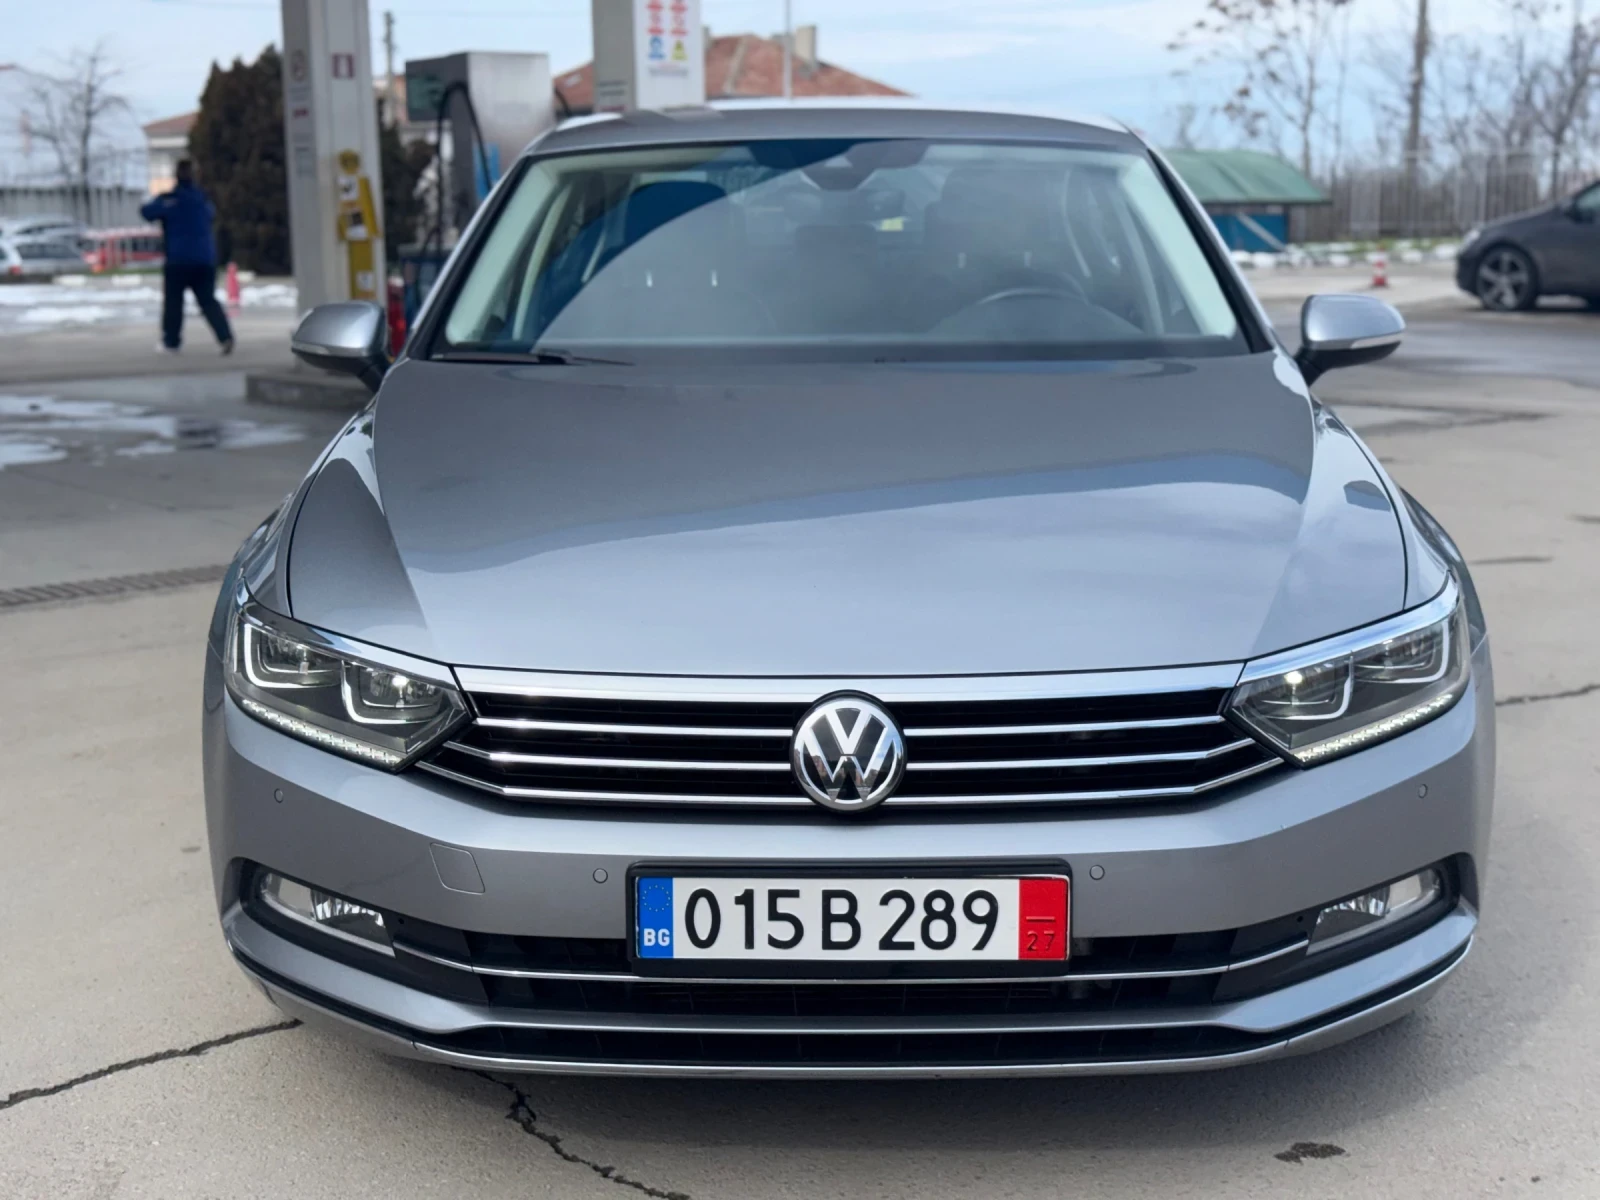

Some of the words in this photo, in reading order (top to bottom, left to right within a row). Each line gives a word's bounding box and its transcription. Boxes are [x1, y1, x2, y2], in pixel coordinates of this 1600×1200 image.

[794, 698, 904, 811] VW
[643, 928, 671, 947] BG
[1026, 930, 1056, 951] 27
